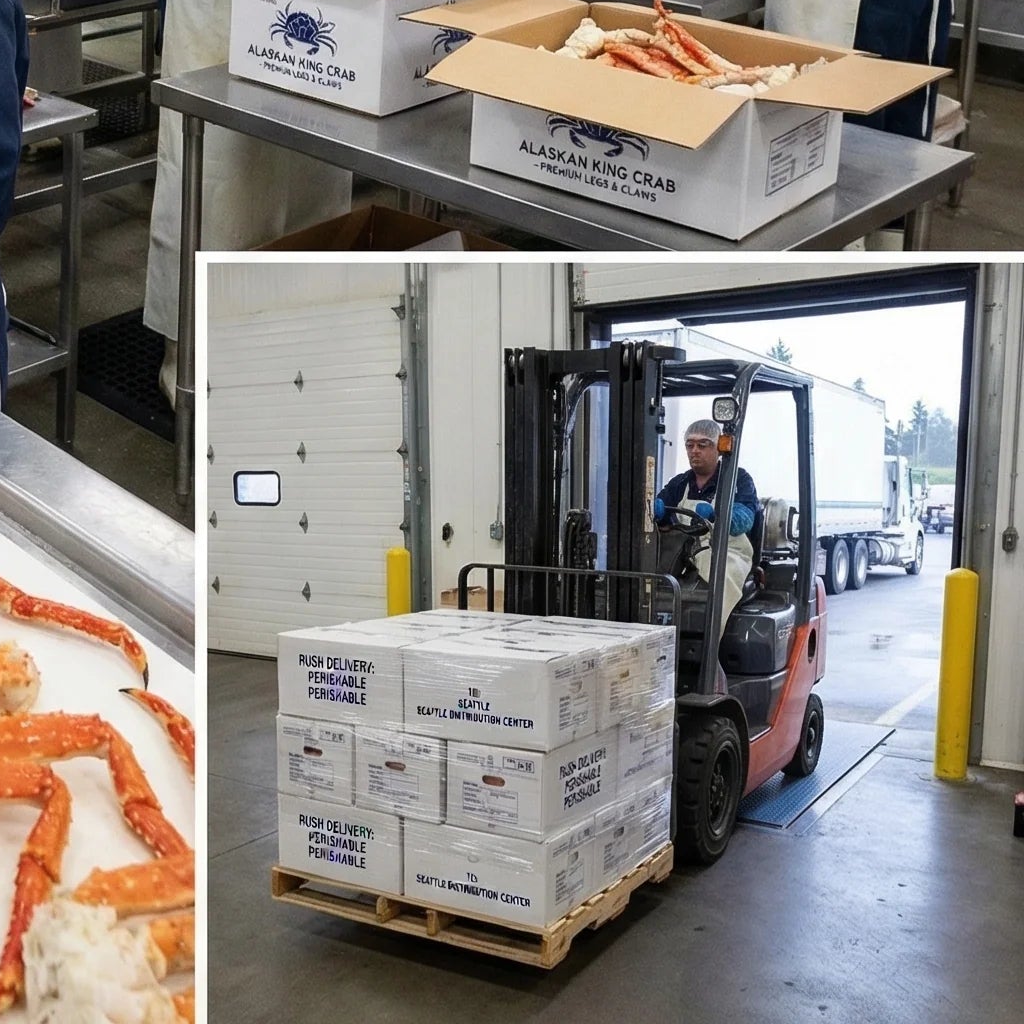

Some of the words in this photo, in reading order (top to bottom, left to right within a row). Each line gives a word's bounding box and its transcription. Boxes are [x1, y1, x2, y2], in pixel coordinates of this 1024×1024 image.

[247, 43, 296, 66] ALASKAN
[298, 56, 324, 74] KING
[326, 64, 356, 82] CRAB
[518, 139, 588, 170] ALASKAN
[592, 158, 628, 180] KING
[632, 170, 677, 194] CRAB
[298, 653, 324, 669] RUSH
[298, 813, 324, 830] RUSH
